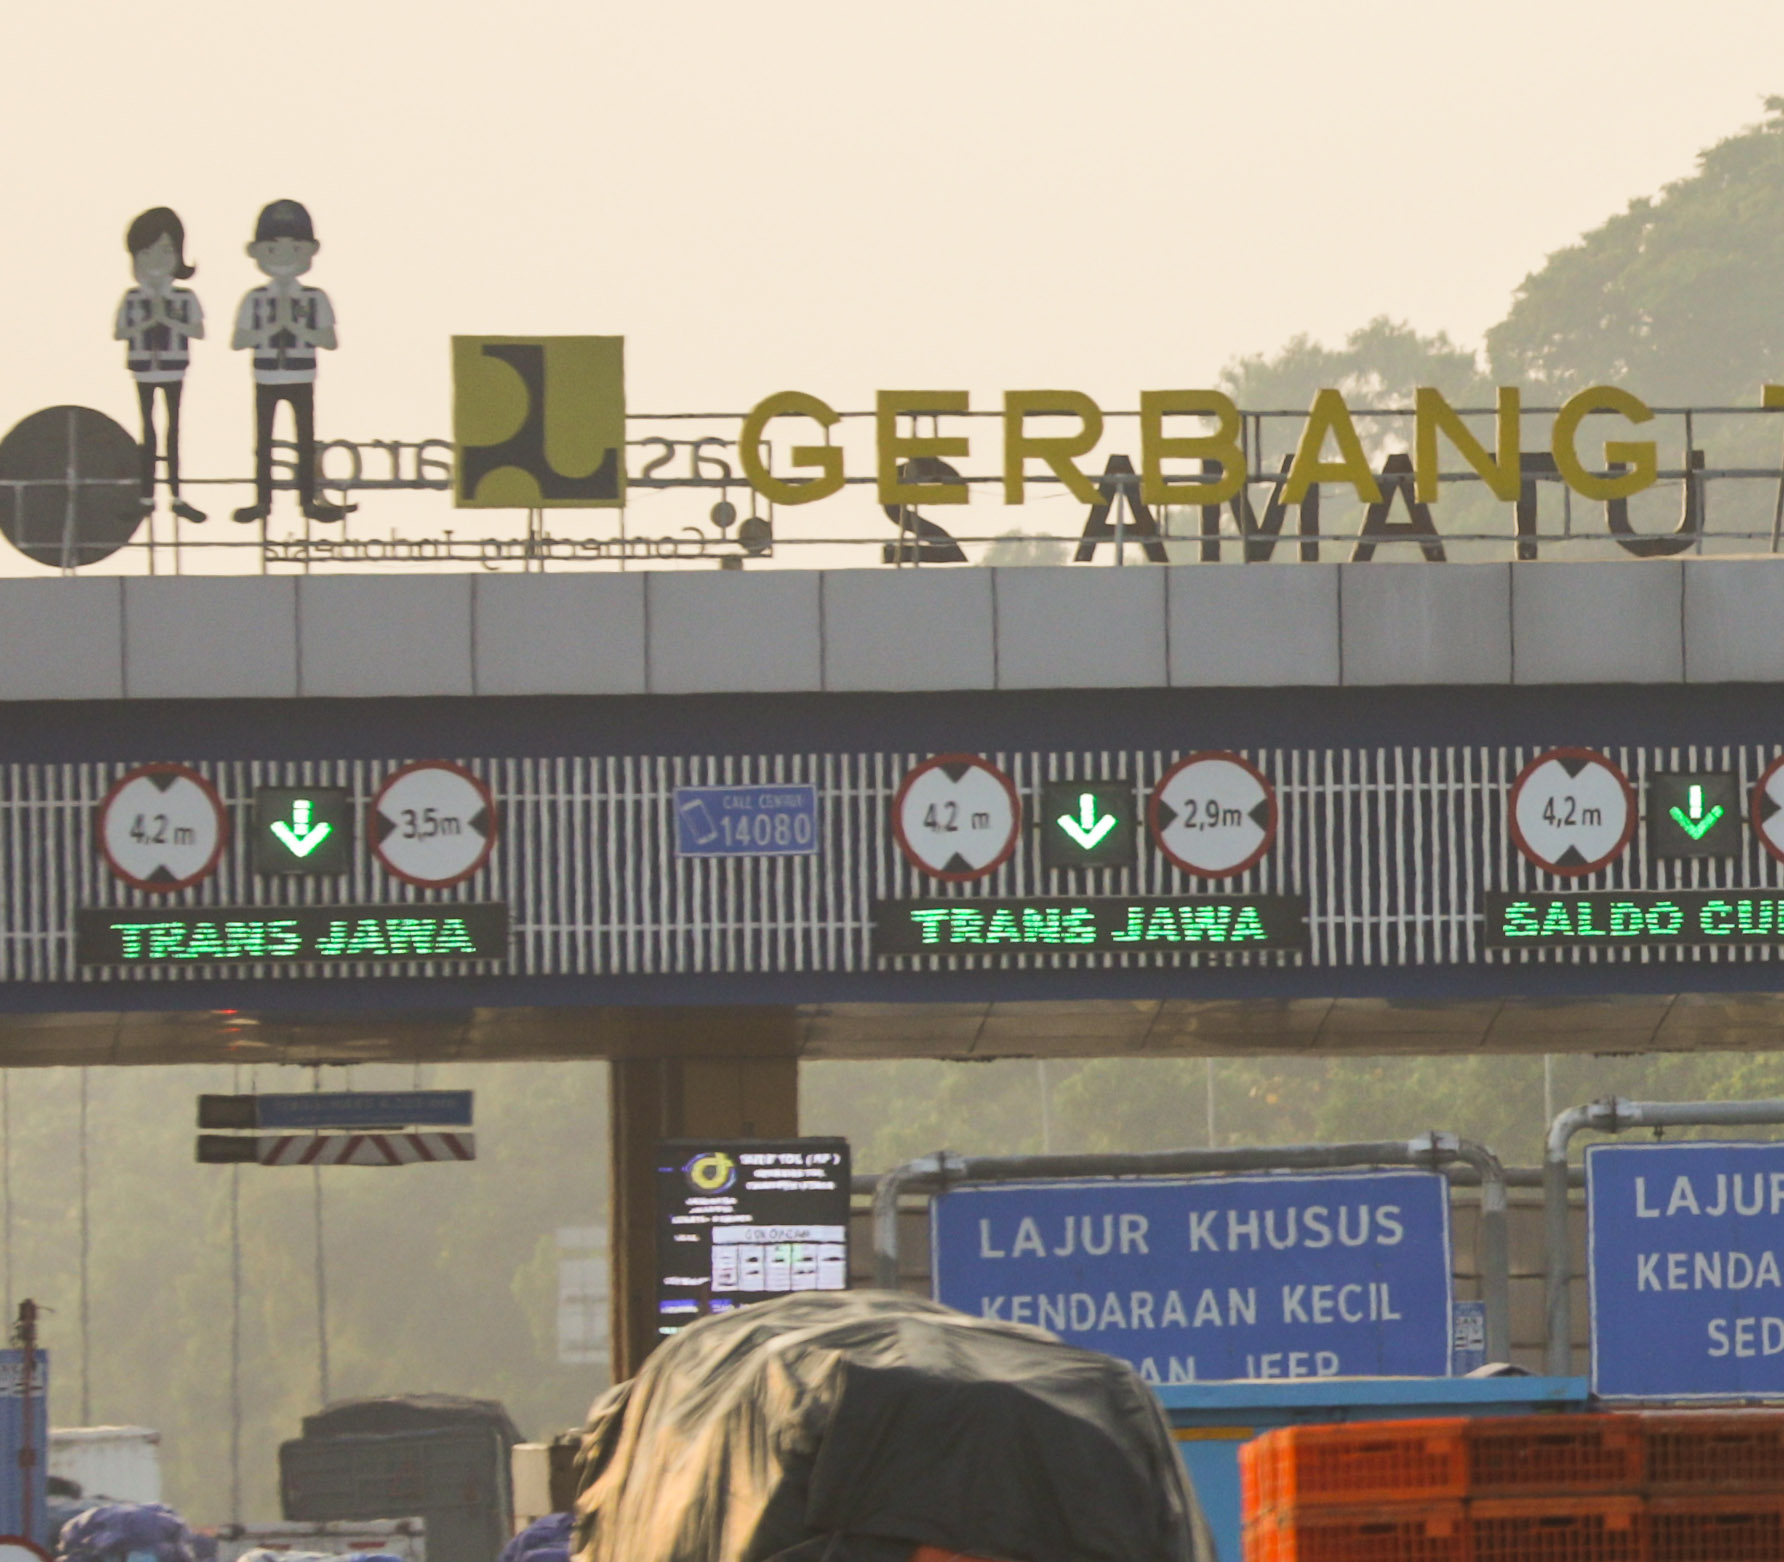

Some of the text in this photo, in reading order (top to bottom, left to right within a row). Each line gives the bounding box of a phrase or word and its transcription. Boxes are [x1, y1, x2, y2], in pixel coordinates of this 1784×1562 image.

[740, 384, 1658, 506] GERBANG
[128, 813, 169, 848] 4,2
[719, 812, 812, 848] 14080
[1541, 796, 1577, 830] 4,2
[110, 916, 477, 960] TRANS JAWA
[910, 904, 1269, 945] TRANS JAWA
[1502, 900, 1685, 937] SALDO
[979, 1204, 1404, 1259] LAJUR KHUSUS
[981, 1283, 1402, 1333] KENDARAAN KECIL
